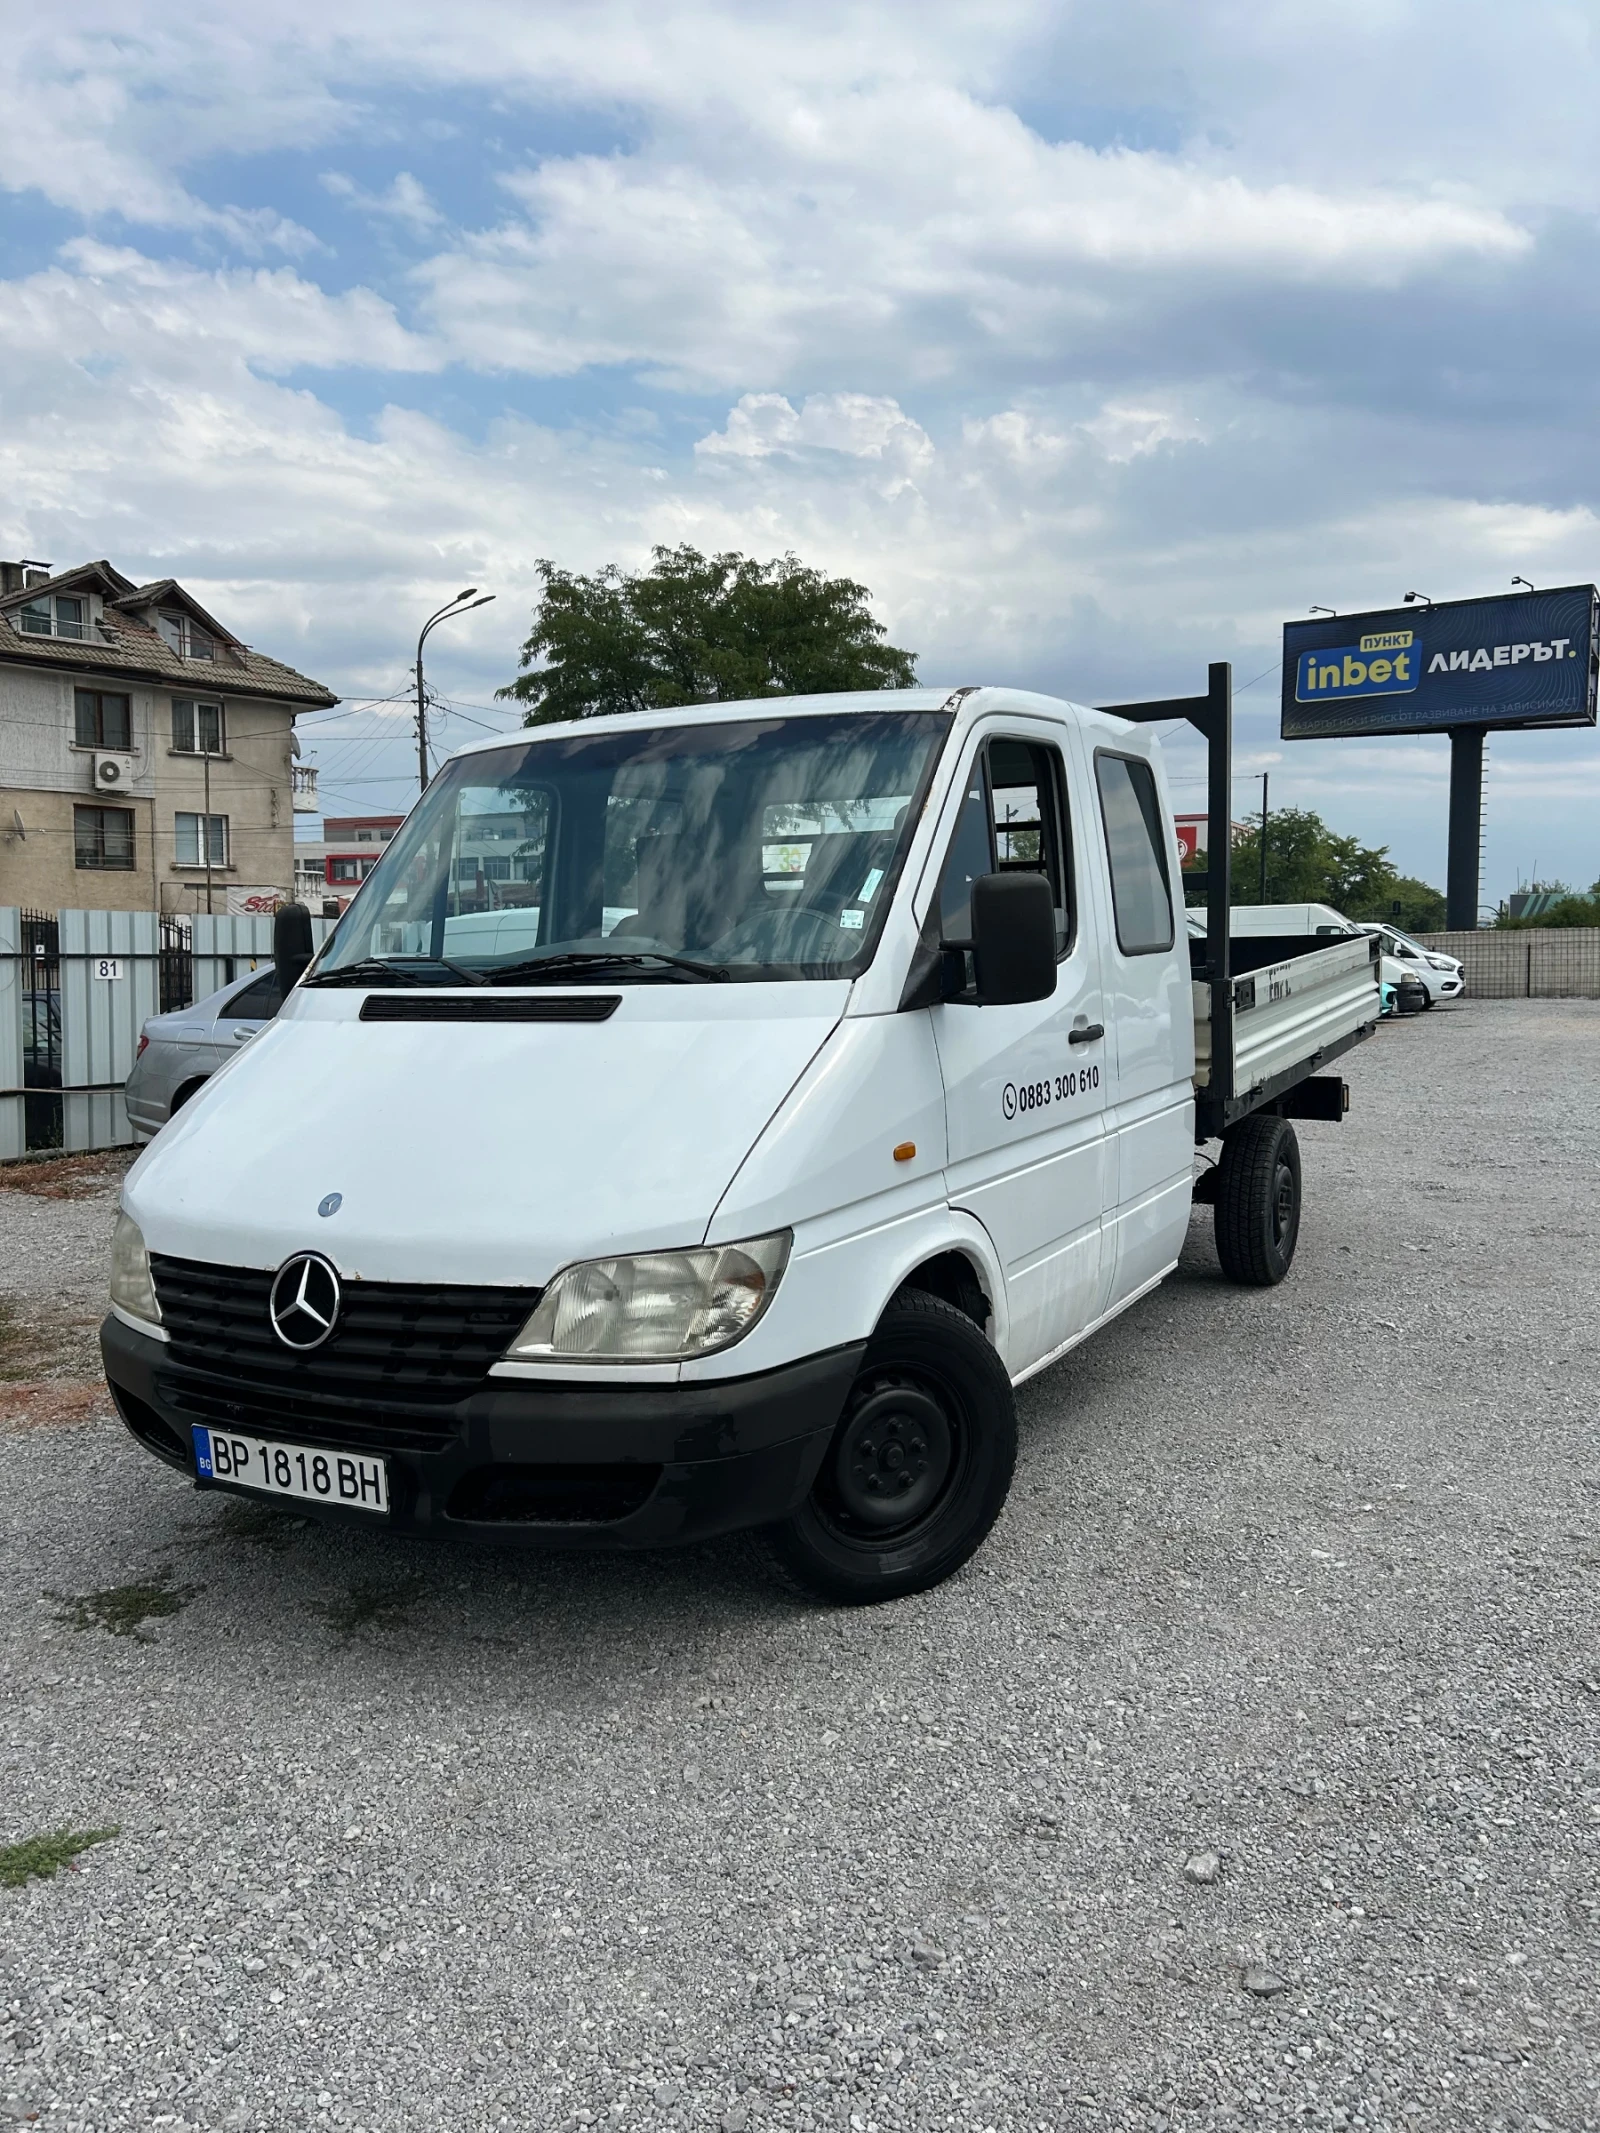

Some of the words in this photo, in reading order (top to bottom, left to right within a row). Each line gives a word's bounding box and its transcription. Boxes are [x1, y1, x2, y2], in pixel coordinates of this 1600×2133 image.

[1364, 634, 1410, 649] ПУНКТ
[1427, 638, 1577, 674] ЛИДЕРЪТ.
[1307, 652, 1410, 690] inbet
[1340, 716, 1368, 726] НОСИ
[1370, 713, 1397, 724] РИСК
[1399, 711, 1412, 721] ОТ
[1415, 706, 1479, 720] РАЗВИВАНЕ
[1481, 704, 1497, 714] НА
[1500, 697, 1577, 713] ЗАВИСИМОСТ
[99, 960, 117, 977] 81
[1019, 1080, 1051, 1112] 0883
[1055, 1072, 1076, 1101] 300
[1079, 1065, 1099, 1093] 610
[199, 1457, 212, 1470] BG
[212, 1436, 249, 1478] BP
[258, 1446, 331, 1495] 1818
[337, 1458, 381, 1505] BH
